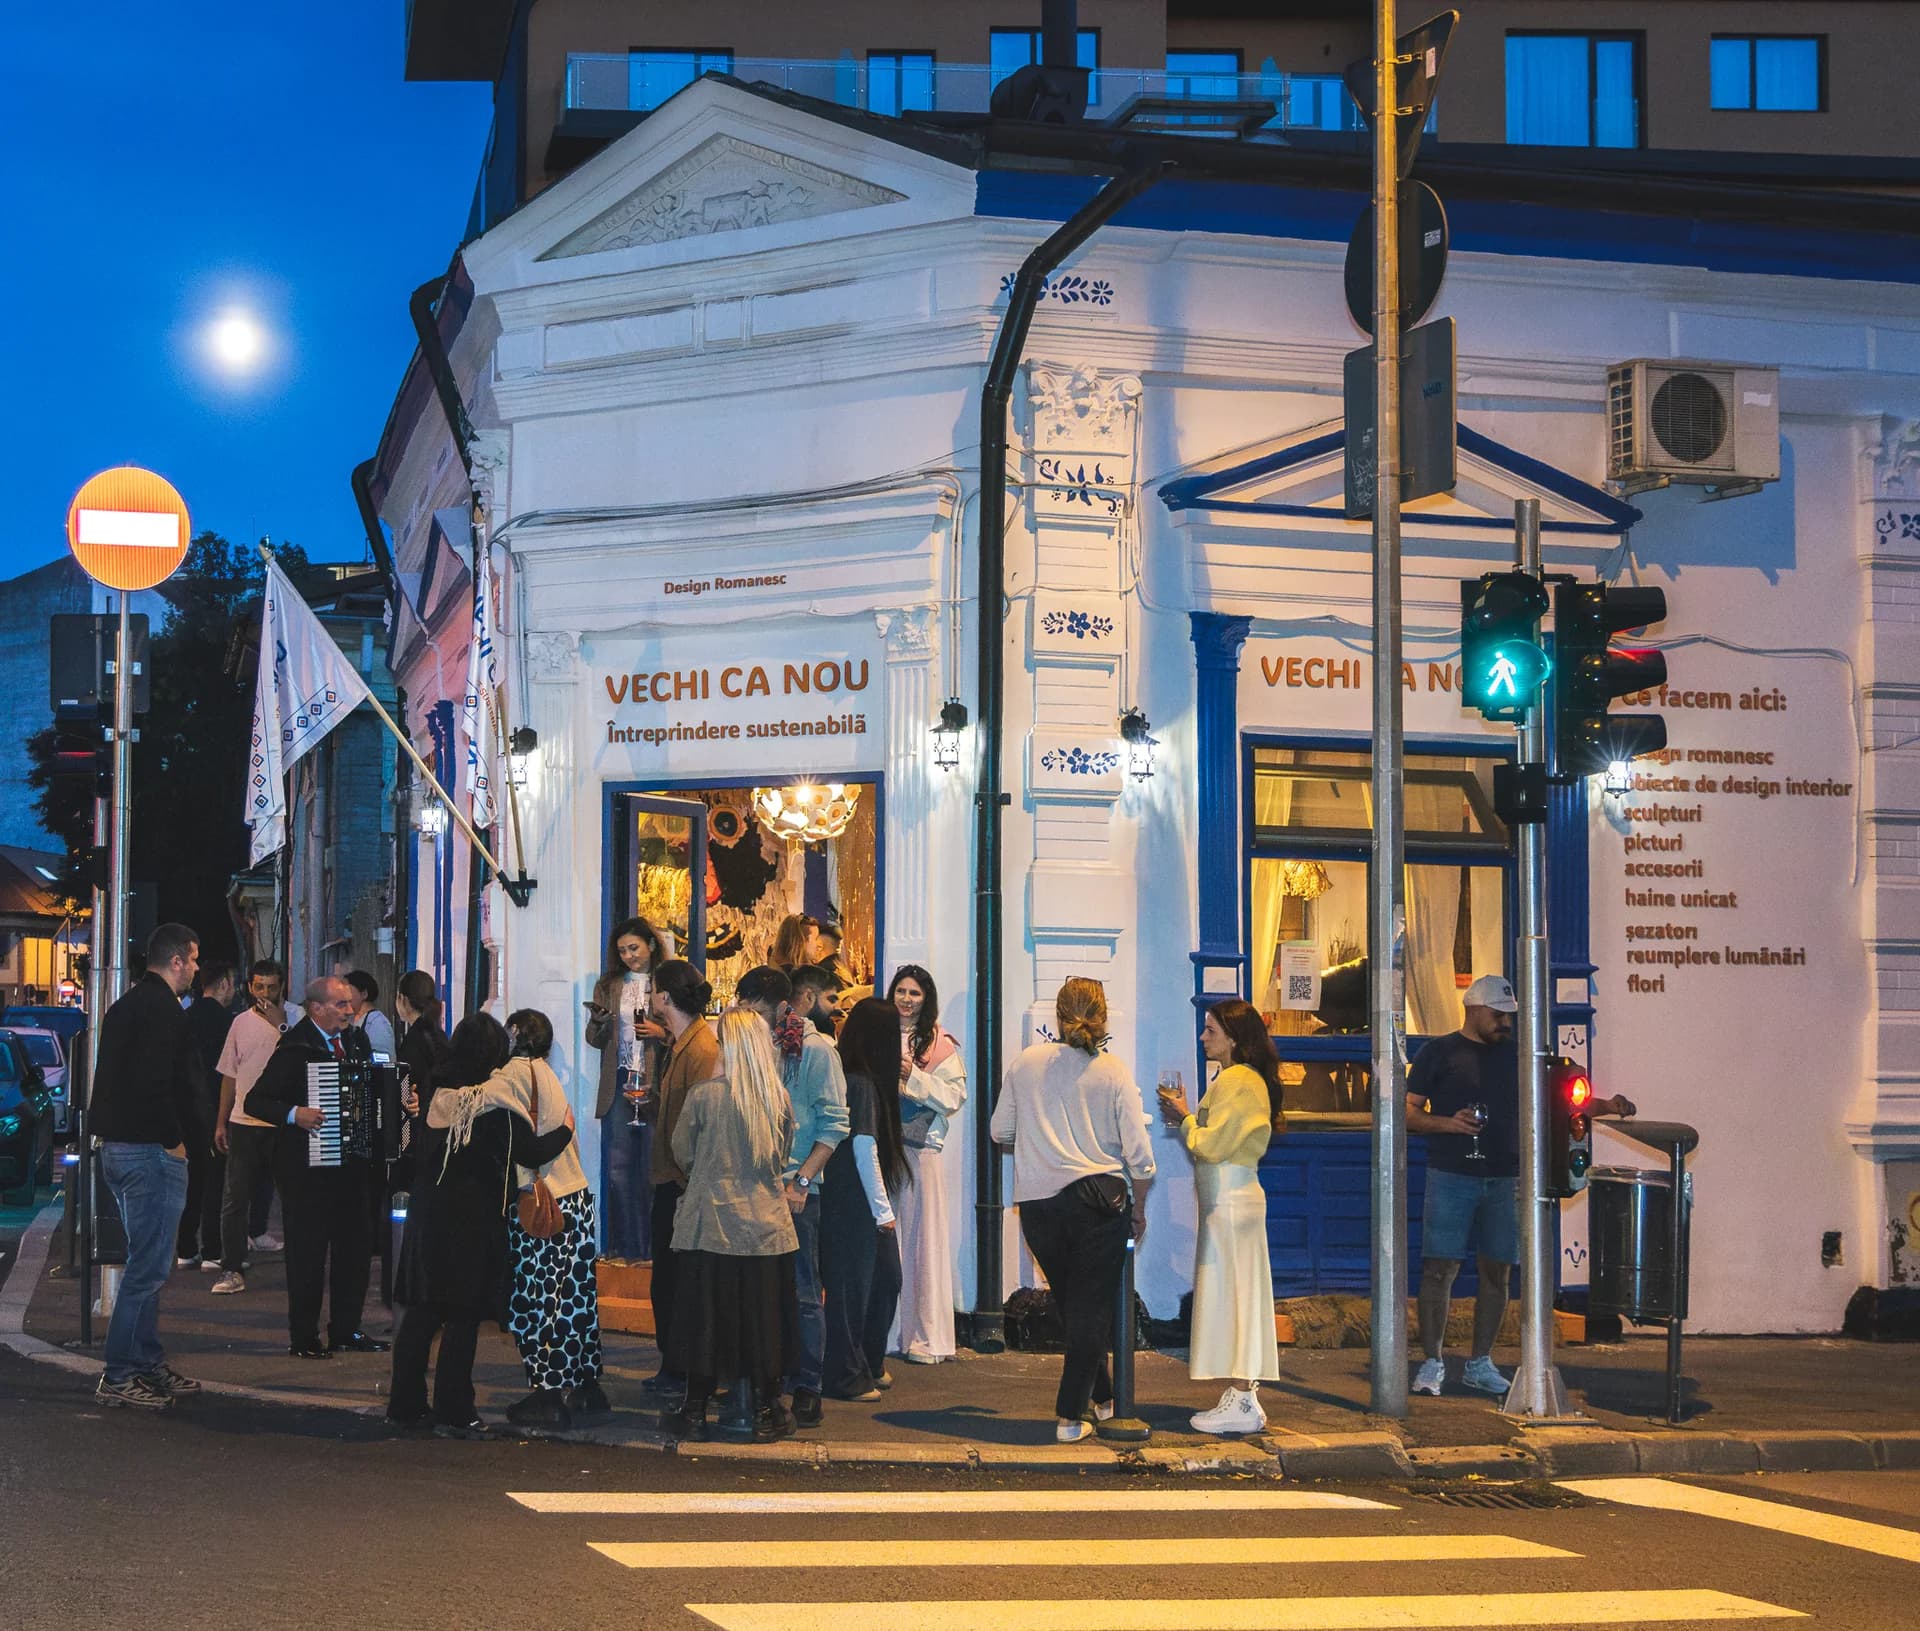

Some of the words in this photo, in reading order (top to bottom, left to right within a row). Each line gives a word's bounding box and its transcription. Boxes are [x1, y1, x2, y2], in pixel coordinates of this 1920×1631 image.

[664, 579, 711, 595] Design
[715, 574, 787, 590] Romanesc
[605, 668, 709, 704] VECHI
[720, 666, 771, 697] CA
[783, 659, 869, 694] NOU
[1260, 655, 1361, 689] VECHI
[1658, 684, 1731, 710] facem
[1739, 687, 1787, 711] aici:
[606, 720, 740, 747] Întreprindere
[1687, 750, 1774, 766] romanesc
[1695, 774, 1718, 793] de
[1722, 775, 1781, 799] design
[1786, 776, 1853, 797] interior
[1623, 802, 1702, 827] sculpturi
[1624, 832, 1683, 856] picturi
[1624, 859, 1703, 878] accesorii
[1625, 888, 1676, 907] haine
[1680, 889, 1738, 909] unicat
[1626, 946, 1720, 968] reumplere
[1626, 974, 1665, 993] flori
